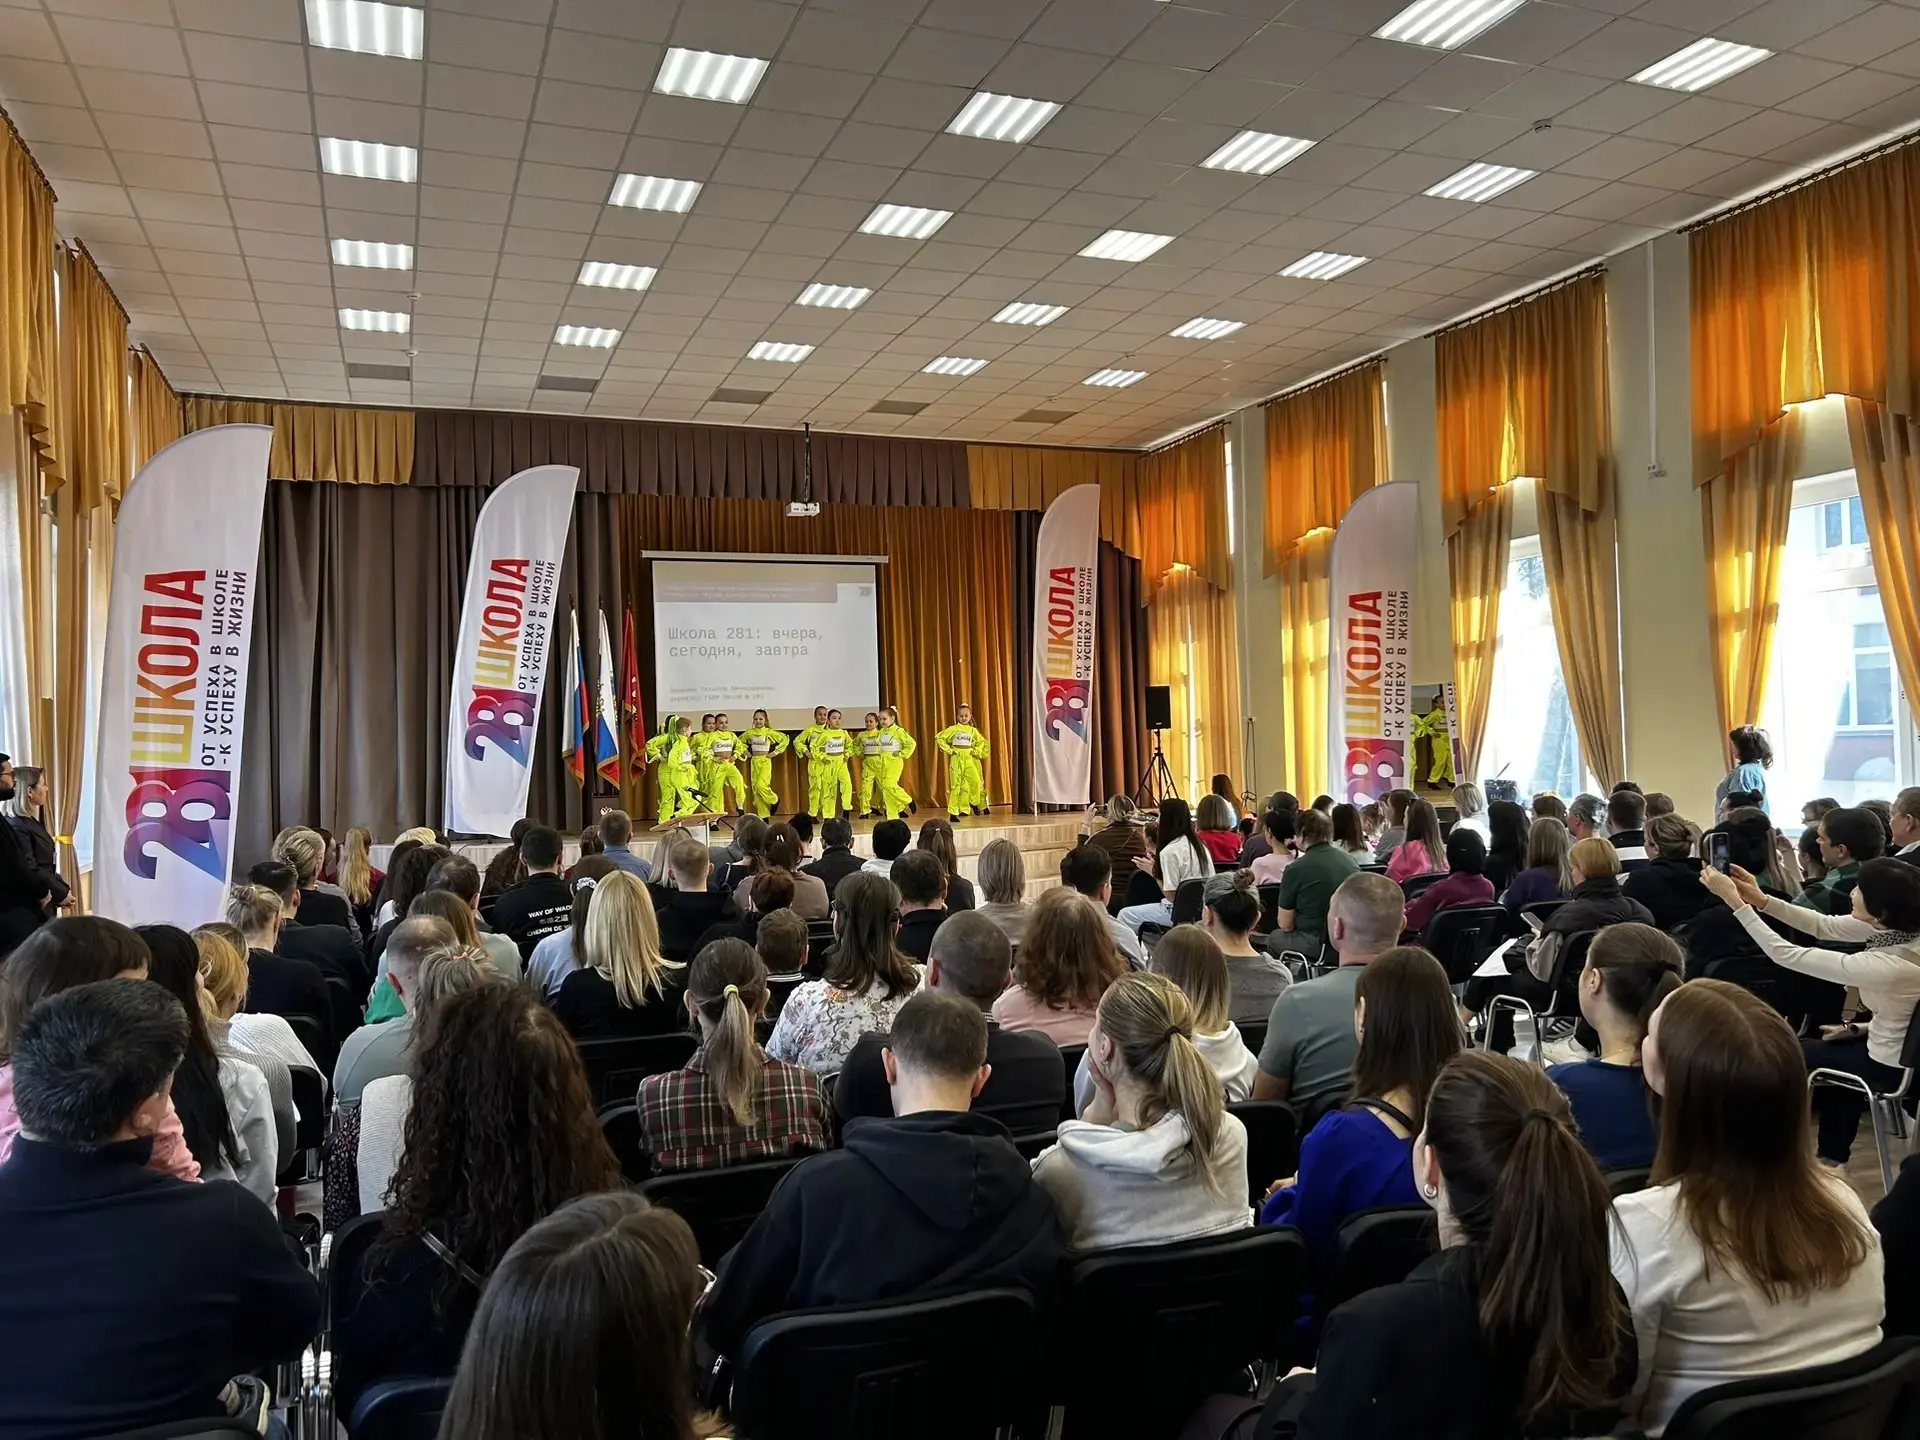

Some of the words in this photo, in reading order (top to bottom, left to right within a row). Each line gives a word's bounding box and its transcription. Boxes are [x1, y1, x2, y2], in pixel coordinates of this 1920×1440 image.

[211, 569, 228, 635] ШКОЛЕ
[227, 571, 247, 637] ЖИЗНИ
[530, 559, 544, 603] ШКОЛЕ
[1078, 566, 1086, 604] ШКОЛЕ
[474, 559, 530, 687] ШКОЛА
[532, 623, 545, 670] УСПЕХУ
[541, 561, 555, 605] ЖИЗНИ
[668, 627, 716, 640] Школа
[726, 627, 760, 640] 281:
[772, 629, 823, 642] вчера,
[1047, 567, 1075, 676] ШКОЛА
[1386, 590, 1397, 640] ШКОЛЕ
[1398, 591, 1408, 640] ЖИЗНИ
[130, 570, 206, 763] ШКОЛА
[210, 645, 221, 655] В
[226, 646, 239, 656] В
[520, 622, 535, 669] УСПЕХА
[669, 645, 743, 659] сегодня,
[755, 644, 809, 658] завтра
[1076, 664, 1082, 678] ОТ
[1345, 591, 1382, 735] ШКОЛА
[1397, 647, 1407, 655] В
[203, 664, 221, 735] УСПЕХА
[220, 665, 237, 735] УСПЕХУ
[518, 674, 527, 690] ОТ
[1384, 661, 1394, 713] УСПЕХА
[1395, 661, 1406, 713] УСПЕХУ
[464, 684, 537, 769] 281
[1045, 677, 1090, 744] 281
[1384, 720, 1391, 737] ОТ
[201, 743, 216, 766] ОТ
[123, 765, 231, 884] 281
